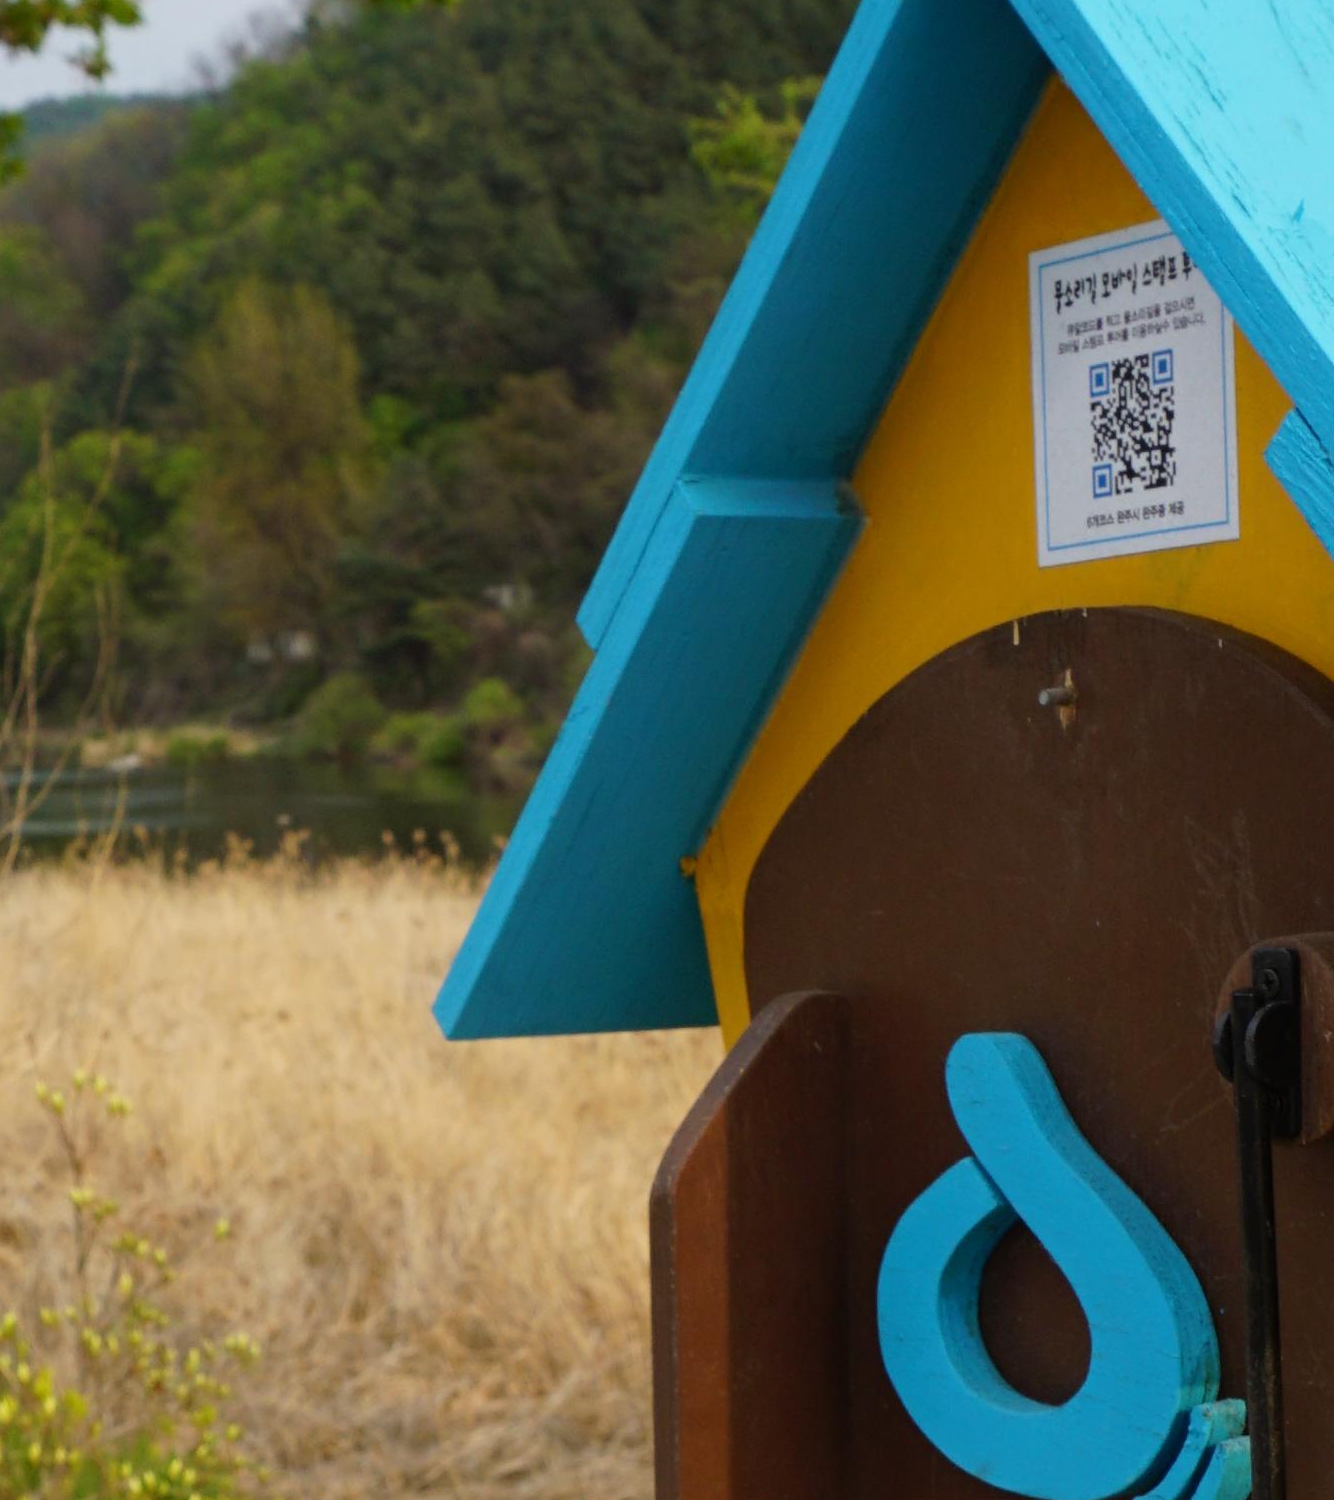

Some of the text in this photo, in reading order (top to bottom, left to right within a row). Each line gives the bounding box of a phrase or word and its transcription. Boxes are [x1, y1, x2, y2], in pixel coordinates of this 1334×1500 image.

[1054, 251, 1199, 315] 물소리길 모바일 스탬프 투
